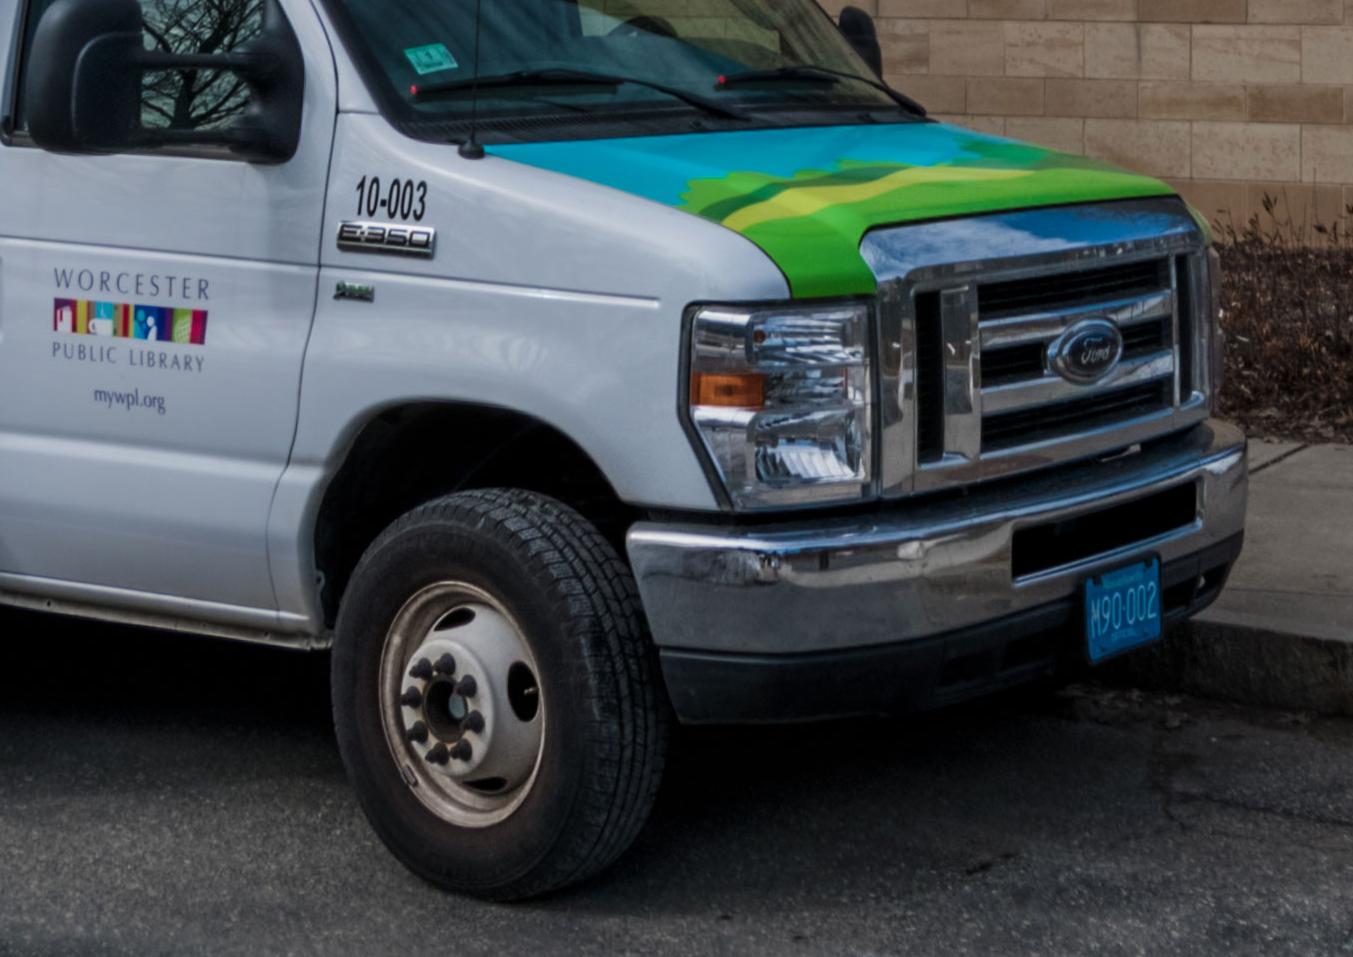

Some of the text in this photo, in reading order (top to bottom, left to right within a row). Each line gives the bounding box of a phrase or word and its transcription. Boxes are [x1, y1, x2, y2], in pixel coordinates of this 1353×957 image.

[356, 175, 428, 221] 10-003
[54, 267, 209, 301] WORCESTER
[52, 341, 205, 374] PUBLIC LIBRARY
[1080, 337, 1112, 365] Ford
[94, 388, 166, 416] mywpl.org
